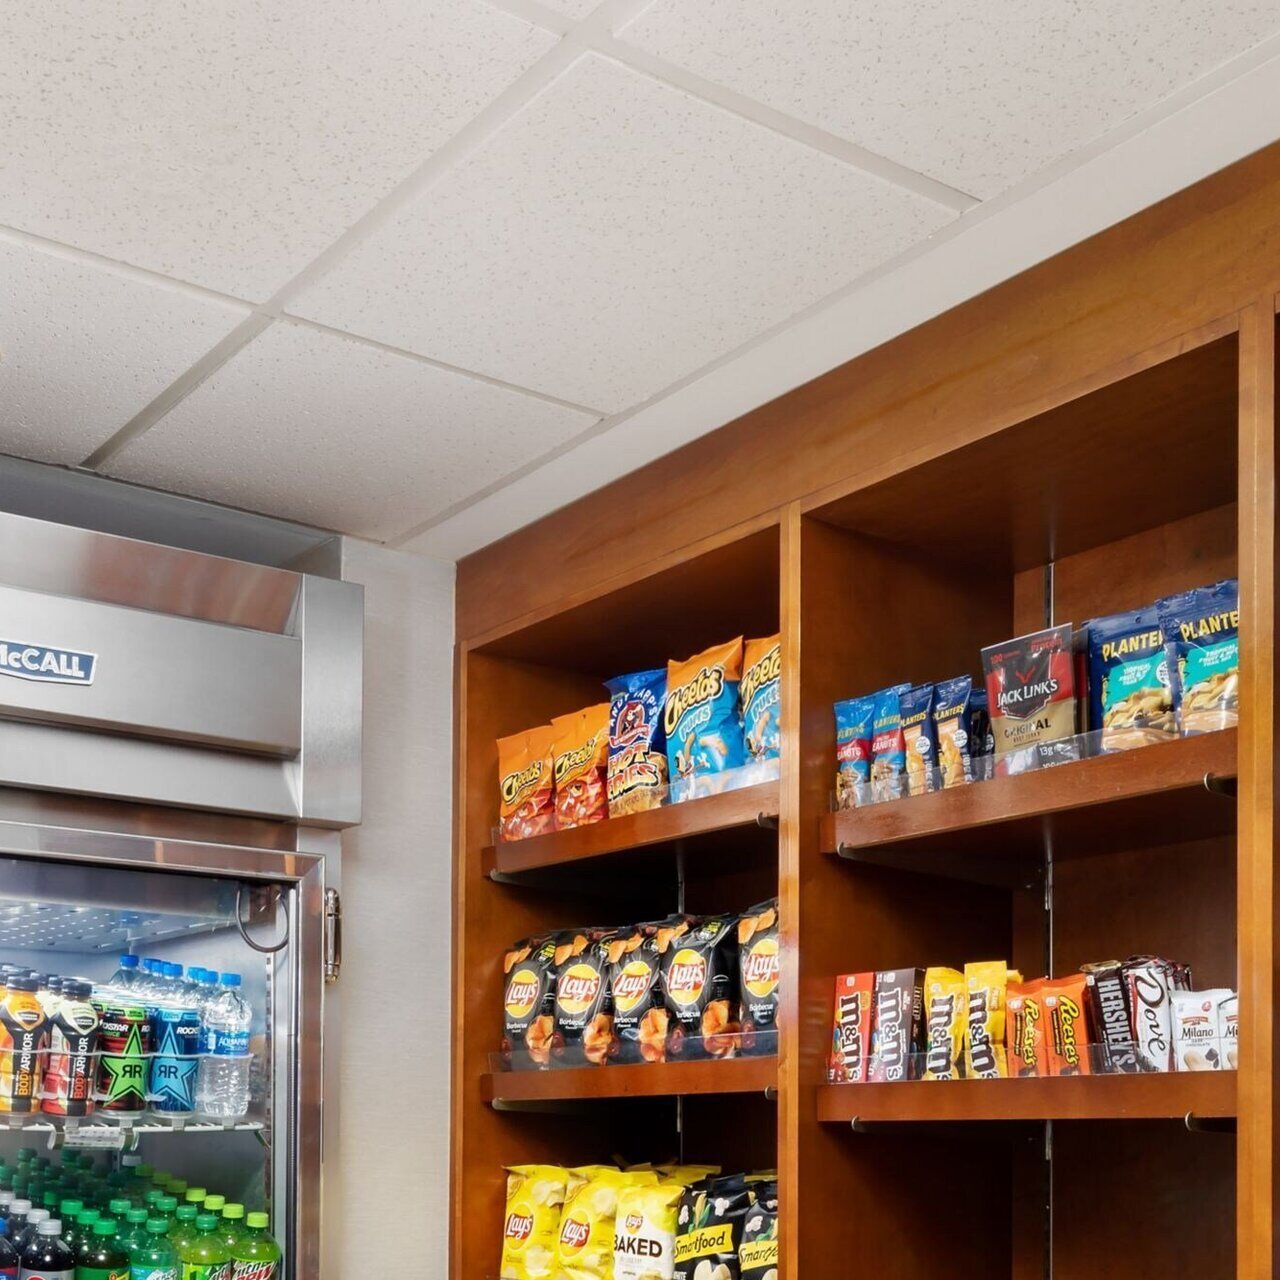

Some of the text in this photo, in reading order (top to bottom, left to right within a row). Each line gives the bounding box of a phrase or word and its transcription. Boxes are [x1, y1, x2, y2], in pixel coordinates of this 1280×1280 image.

[665, 668, 724, 735] Cheetos
[996, 678, 1059, 708] JACK LINK'S
[1003, 717, 1051, 738] ORIGINAL
[609, 743, 650, 777] HOT
[501, 761, 543, 804] Cheetos
[1098, 979, 1137, 1073] HERSHEY'S
[1135, 968, 1168, 1057] Dove
[1017, 998, 1039, 1066] Reese's
[1182, 1027, 1214, 1038] Milano
[18, 1032, 33, 1095] BODYARMOR
[614, 1235, 662, 1258] BAKED
[675, 1232, 725, 1259] Smartfood
